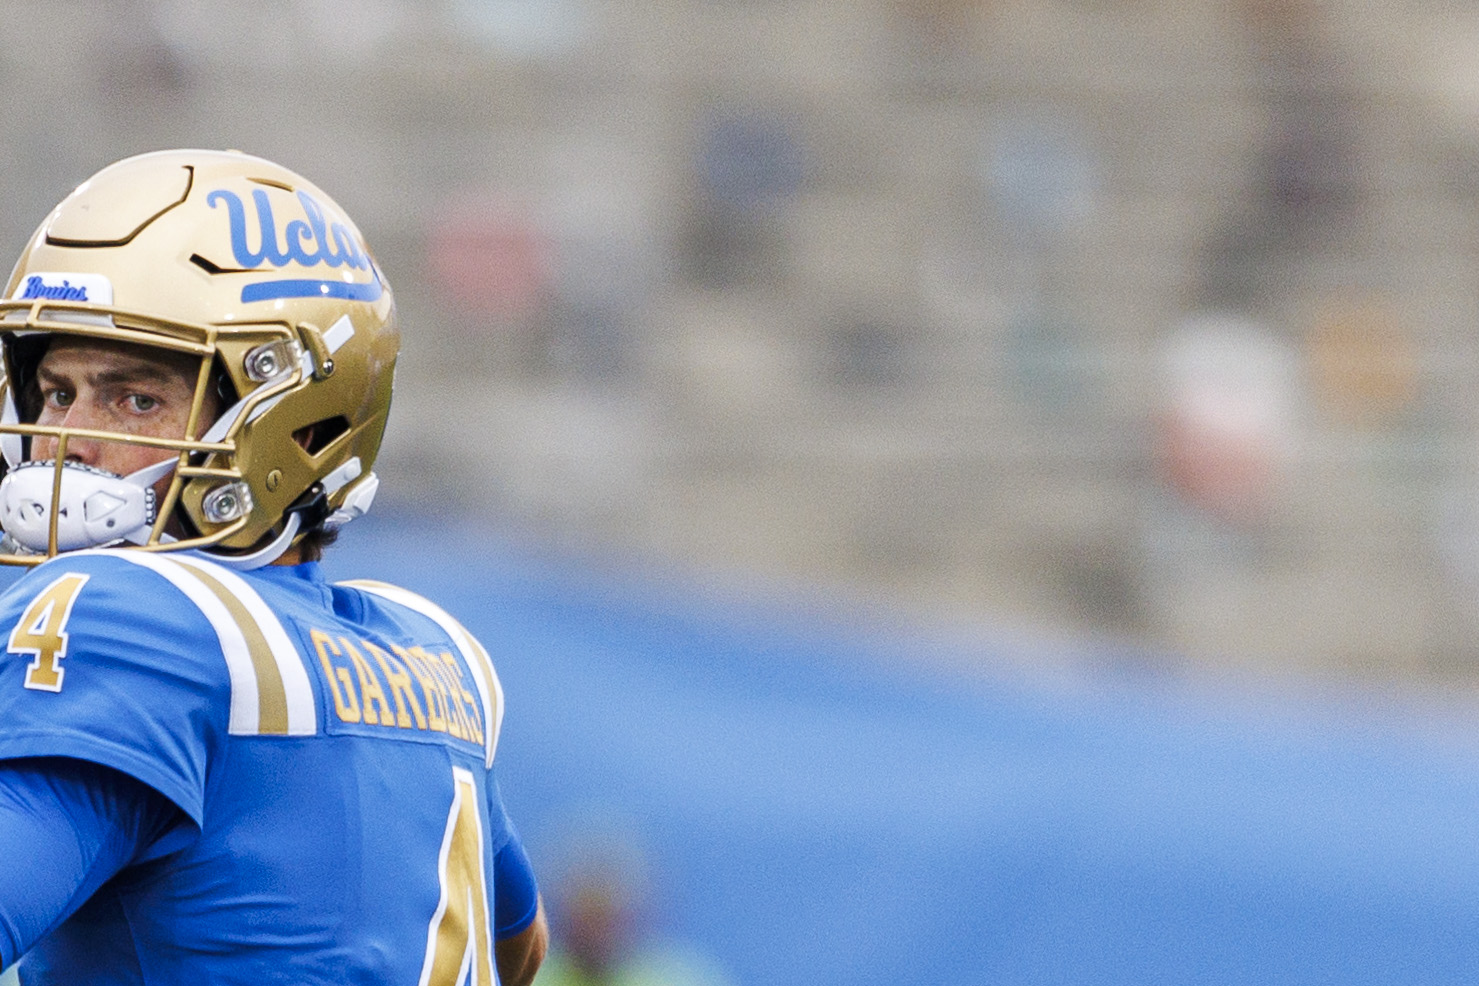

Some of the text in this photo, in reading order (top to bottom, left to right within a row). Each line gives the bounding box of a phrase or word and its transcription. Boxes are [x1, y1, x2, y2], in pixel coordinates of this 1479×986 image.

[206, 188, 372, 273] Ucla
[20, 276, 88, 302] Bruins
[6, 571, 91, 693] 4
[310, 628, 485, 747] GARBERS
